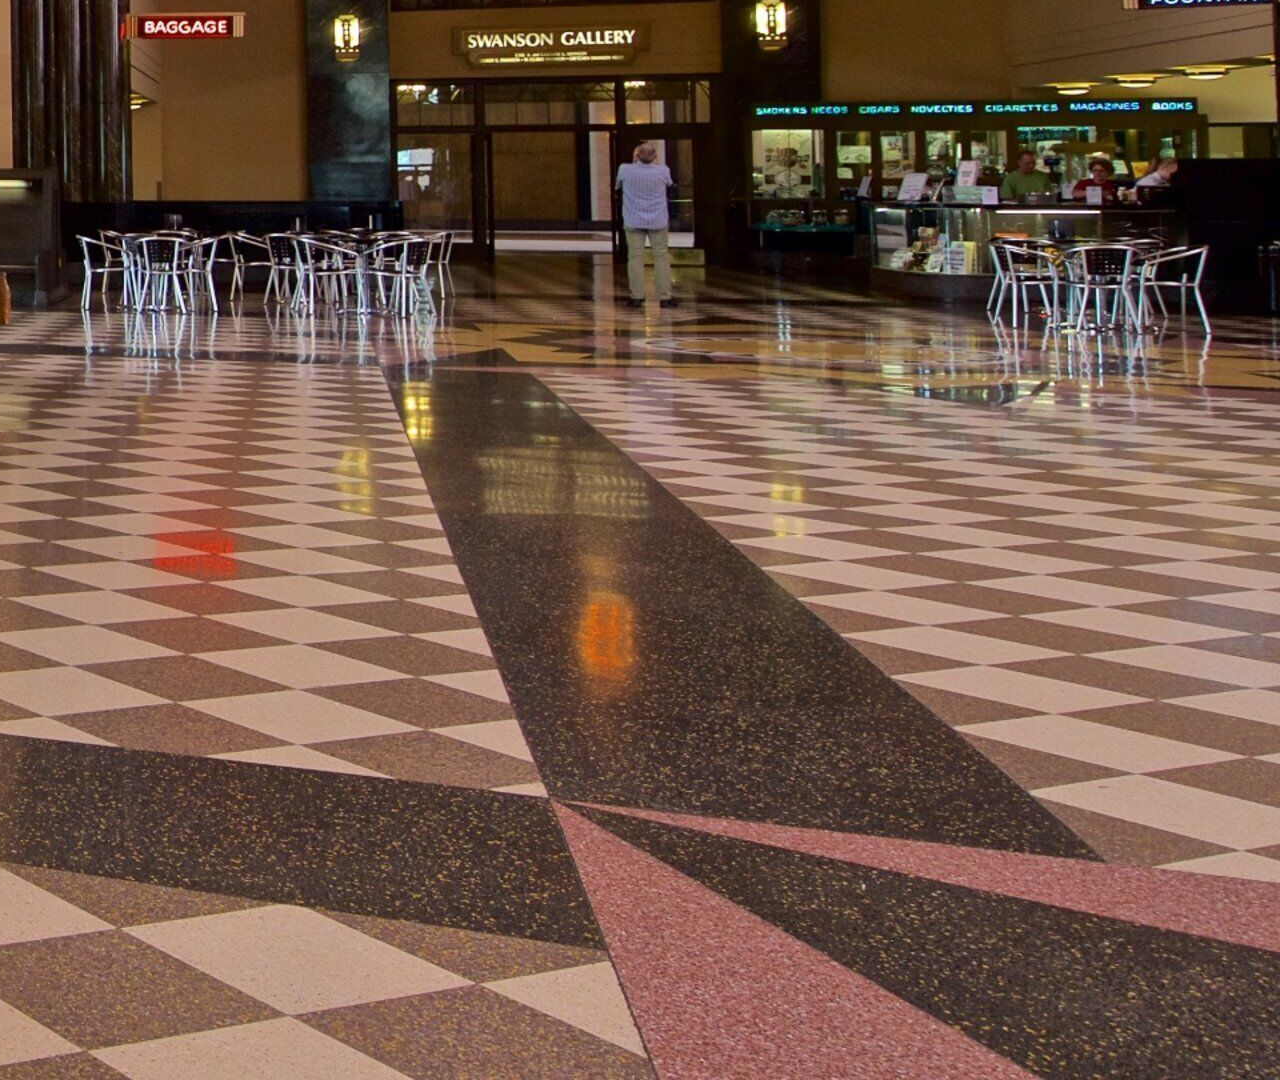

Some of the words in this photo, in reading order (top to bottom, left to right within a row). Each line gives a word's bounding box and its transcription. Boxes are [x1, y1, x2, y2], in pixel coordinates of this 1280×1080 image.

[144, 20, 227, 34] BAGGAGE
[468, 32, 554, 48] SWANSON
[560, 30, 636, 46] GALLERY
[755, 106, 808, 115] SMOKERS
[811, 106, 849, 114] NEEDS
[859, 105, 900, 113] CIGARS
[985, 104, 1059, 112] CIGARETTES
[1070, 102, 1141, 111] MAGAZINES
[1152, 102, 1193, 110] BOOKS
